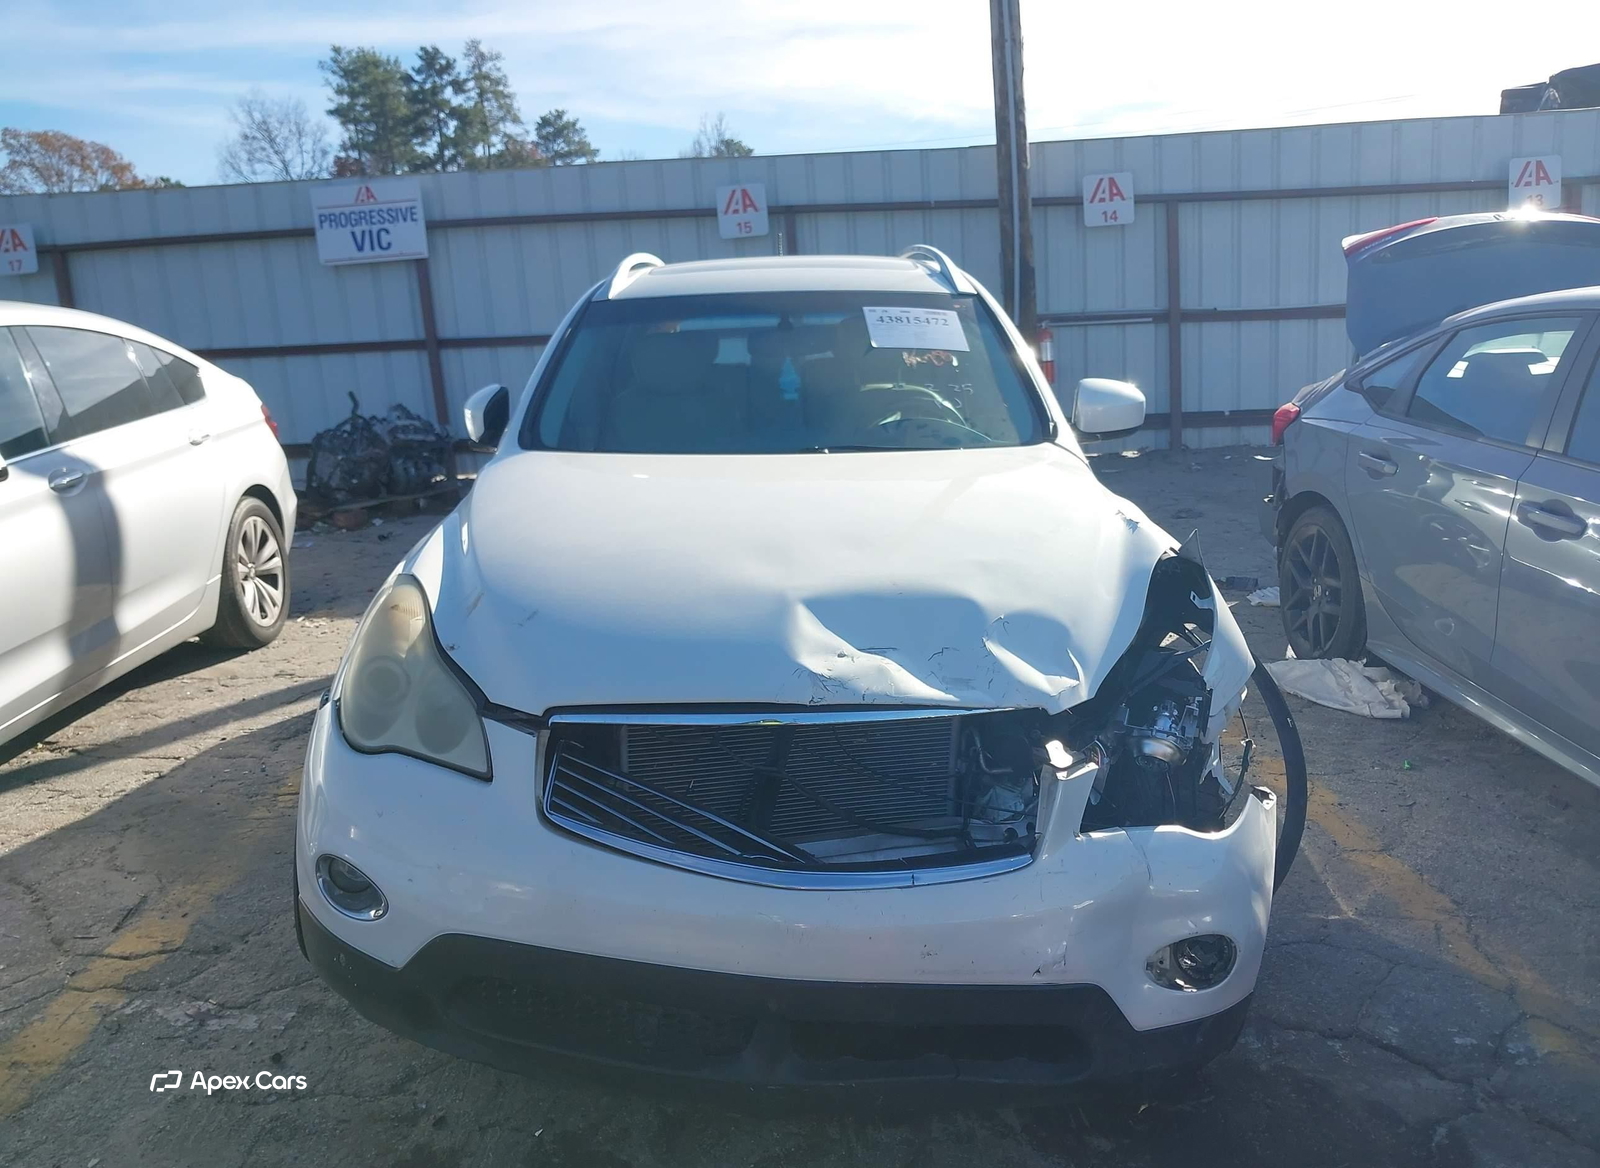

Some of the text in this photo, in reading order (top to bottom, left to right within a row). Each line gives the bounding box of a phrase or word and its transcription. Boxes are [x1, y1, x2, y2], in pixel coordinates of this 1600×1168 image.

[1526, 193, 1544, 207] 13
[317, 205, 419, 230] PROGRESSIVE
[1101, 209, 1119, 223] 14
[736, 221, 753, 234] 15
[350, 227, 392, 253] VIC
[8, 259, 23, 272] 17
[875, 314, 949, 327] 43815472
